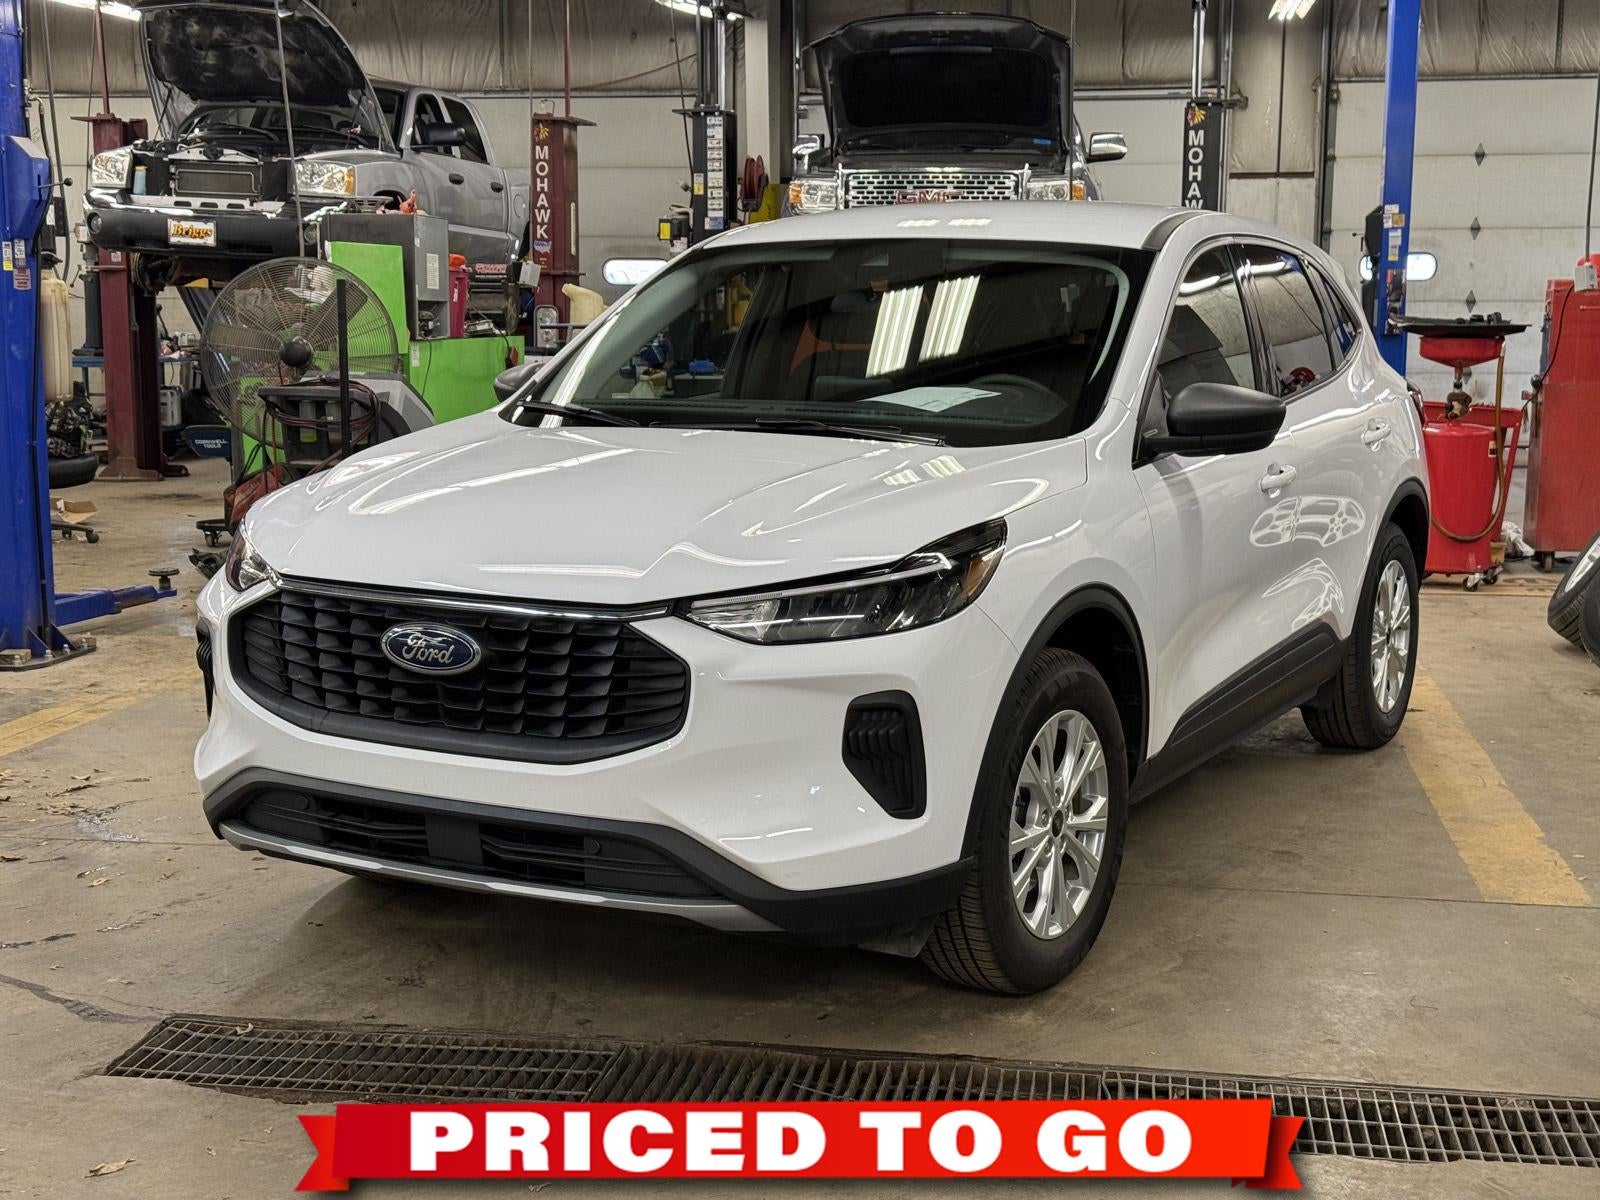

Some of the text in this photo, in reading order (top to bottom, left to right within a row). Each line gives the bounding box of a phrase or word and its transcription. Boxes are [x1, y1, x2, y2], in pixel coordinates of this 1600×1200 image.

[534, 145, 551, 239] MOHAWK
[895, 188, 964, 204] GMC
[171, 223, 213, 239] Briggs
[397, 632, 455, 664] Ford
